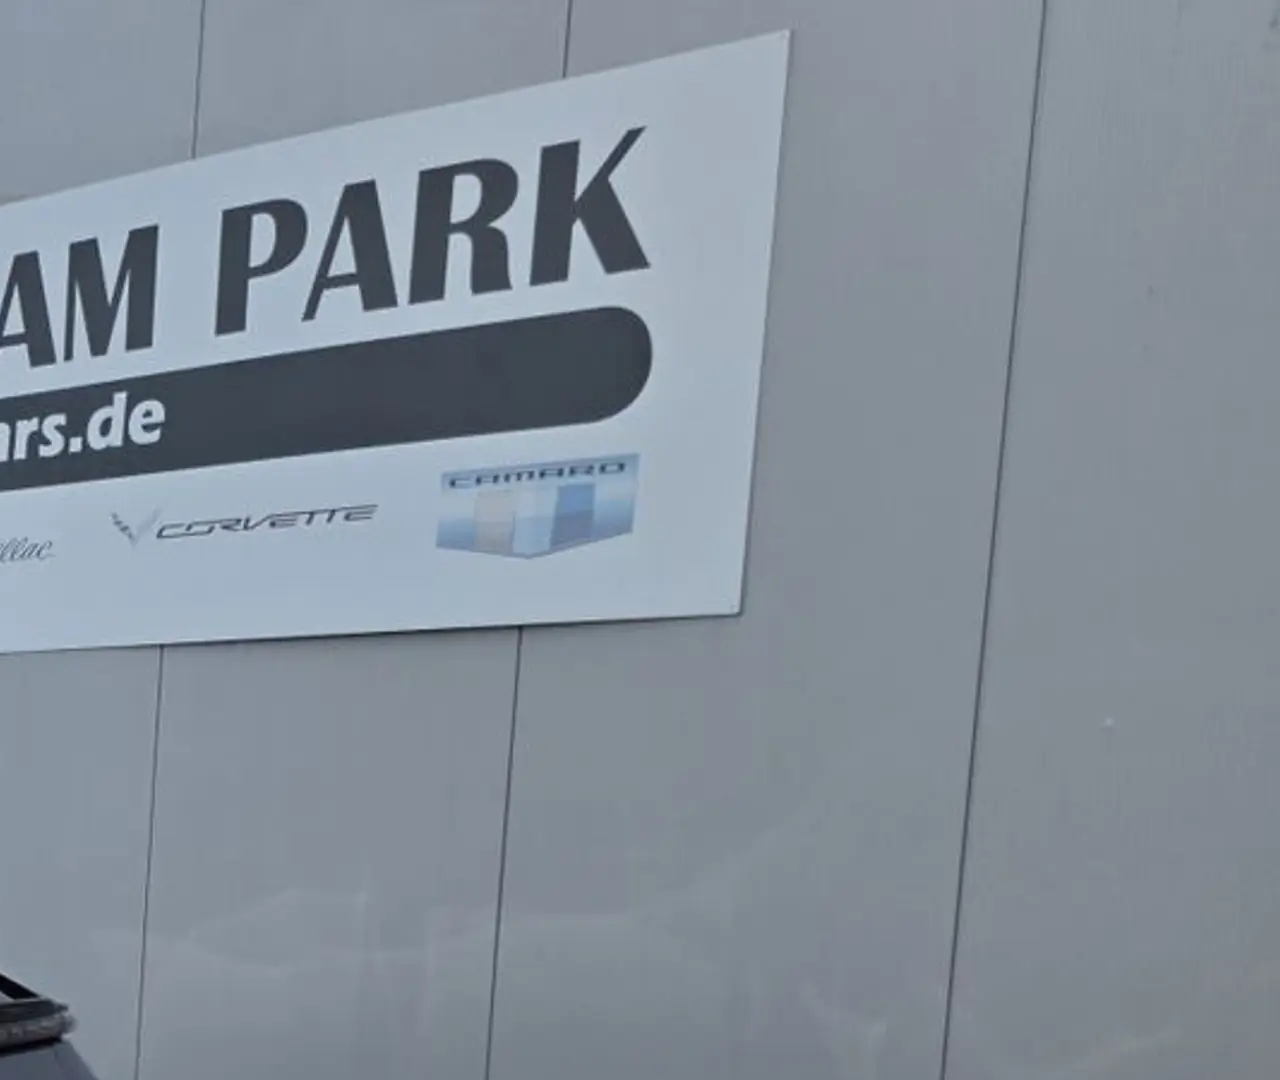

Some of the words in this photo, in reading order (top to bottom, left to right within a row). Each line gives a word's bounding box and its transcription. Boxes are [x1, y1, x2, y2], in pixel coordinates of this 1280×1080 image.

[215, 127, 651, 335] PARK
[448, 461, 626, 490] CAMARO
[156, 503, 378, 539] CORVETTE
